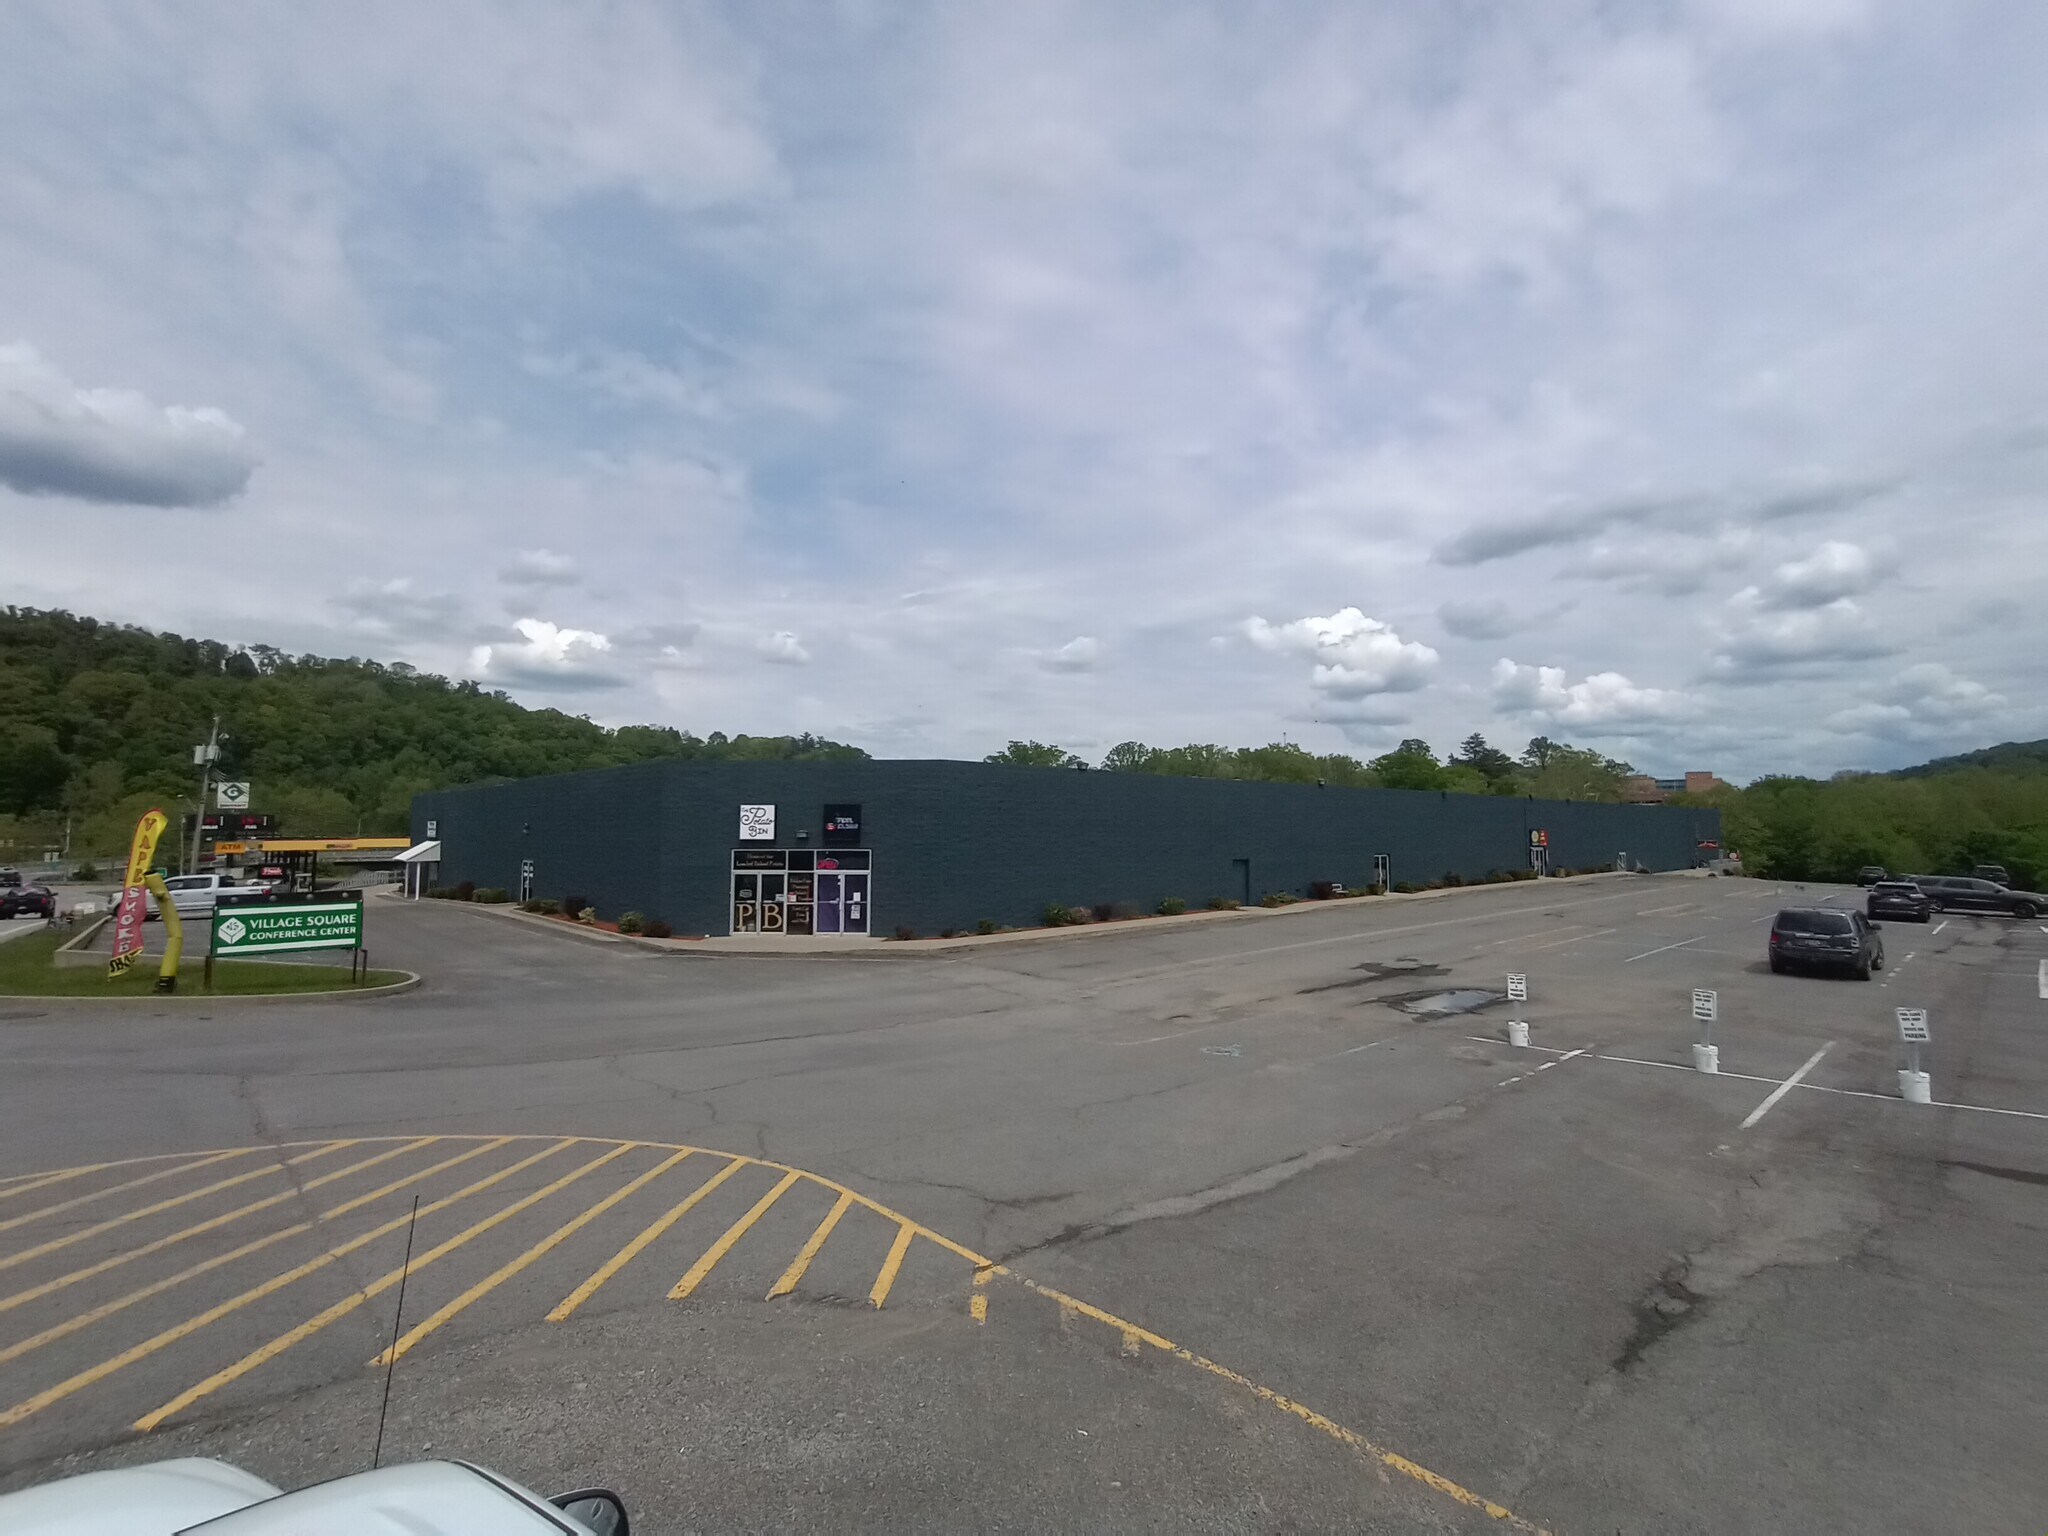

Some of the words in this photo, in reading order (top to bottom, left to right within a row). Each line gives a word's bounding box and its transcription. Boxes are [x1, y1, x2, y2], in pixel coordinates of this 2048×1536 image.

[132, 817, 158, 884] VAPE
[250, 917, 303, 929] VILLAGE
[307, 914, 357, 927] SQUARE
[762, 903, 783, 929] B
[249, 928, 317, 941] CONFERENCE
[320, 926, 356, 936] CENTER
